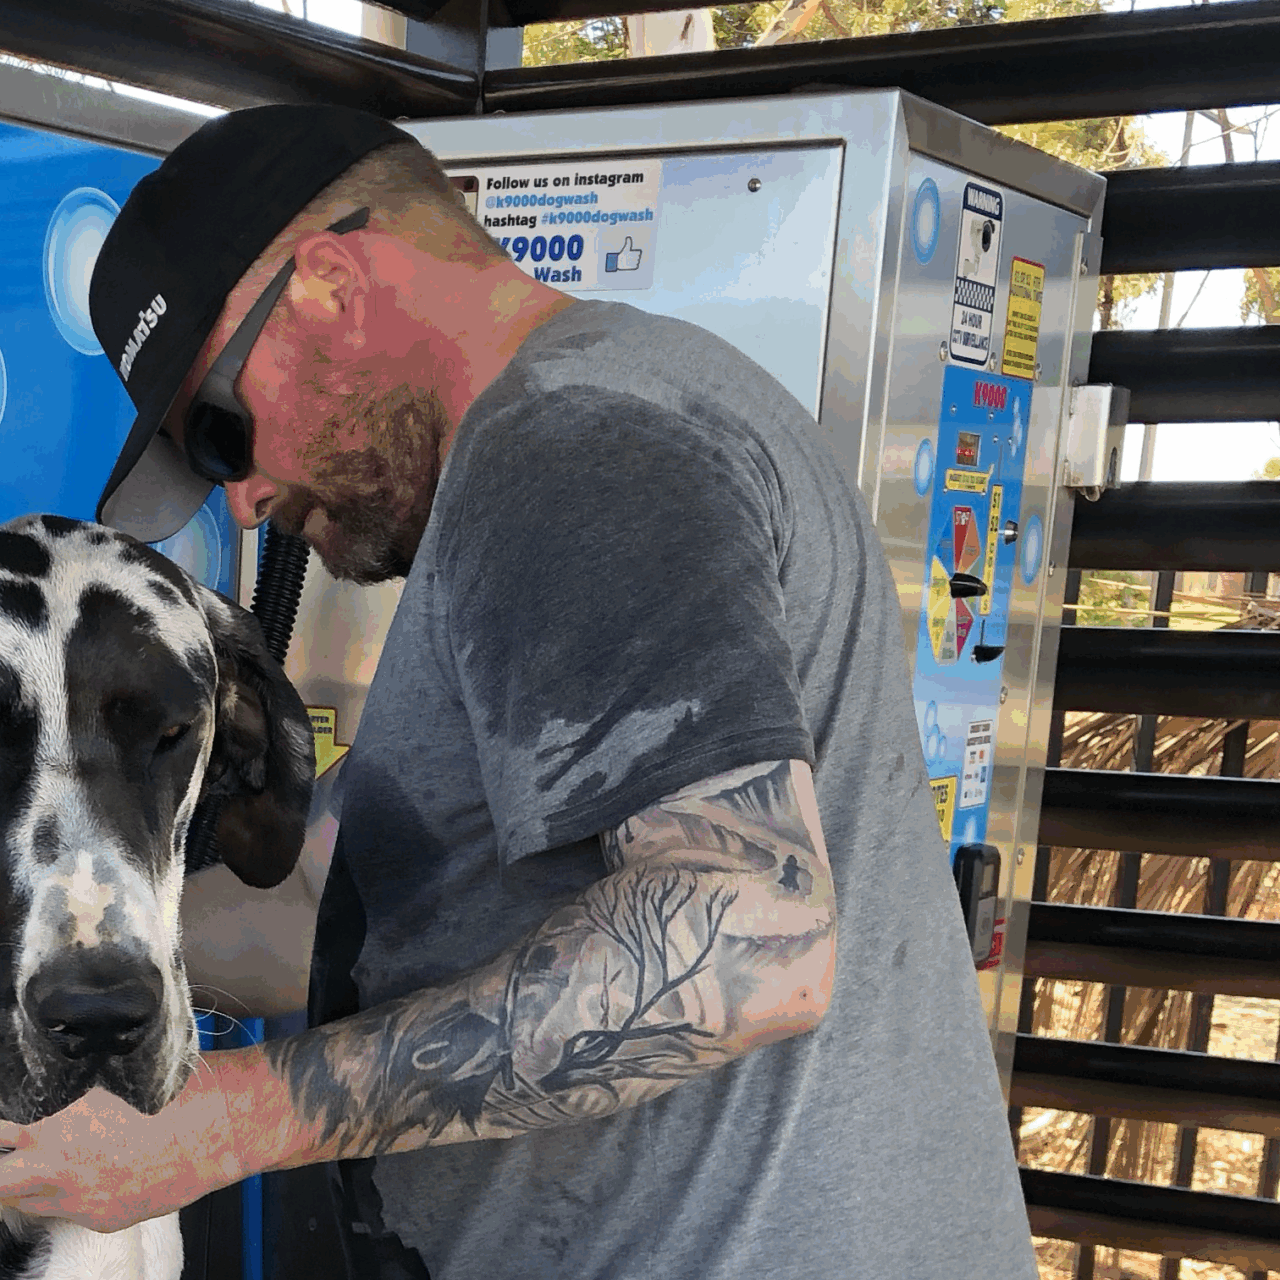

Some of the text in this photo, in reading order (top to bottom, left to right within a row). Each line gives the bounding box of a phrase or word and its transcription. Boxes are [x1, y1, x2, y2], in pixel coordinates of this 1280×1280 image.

[486, 172, 644, 190] Follow us on instagram
[485, 191, 599, 209] @k9000dogwash
[967, 186, 1001, 216] WARNING
[483, 208, 654, 229] hashtag #k9000dogwash
[500, 234, 584, 263] 9000
[533, 266, 582, 283] Wash
